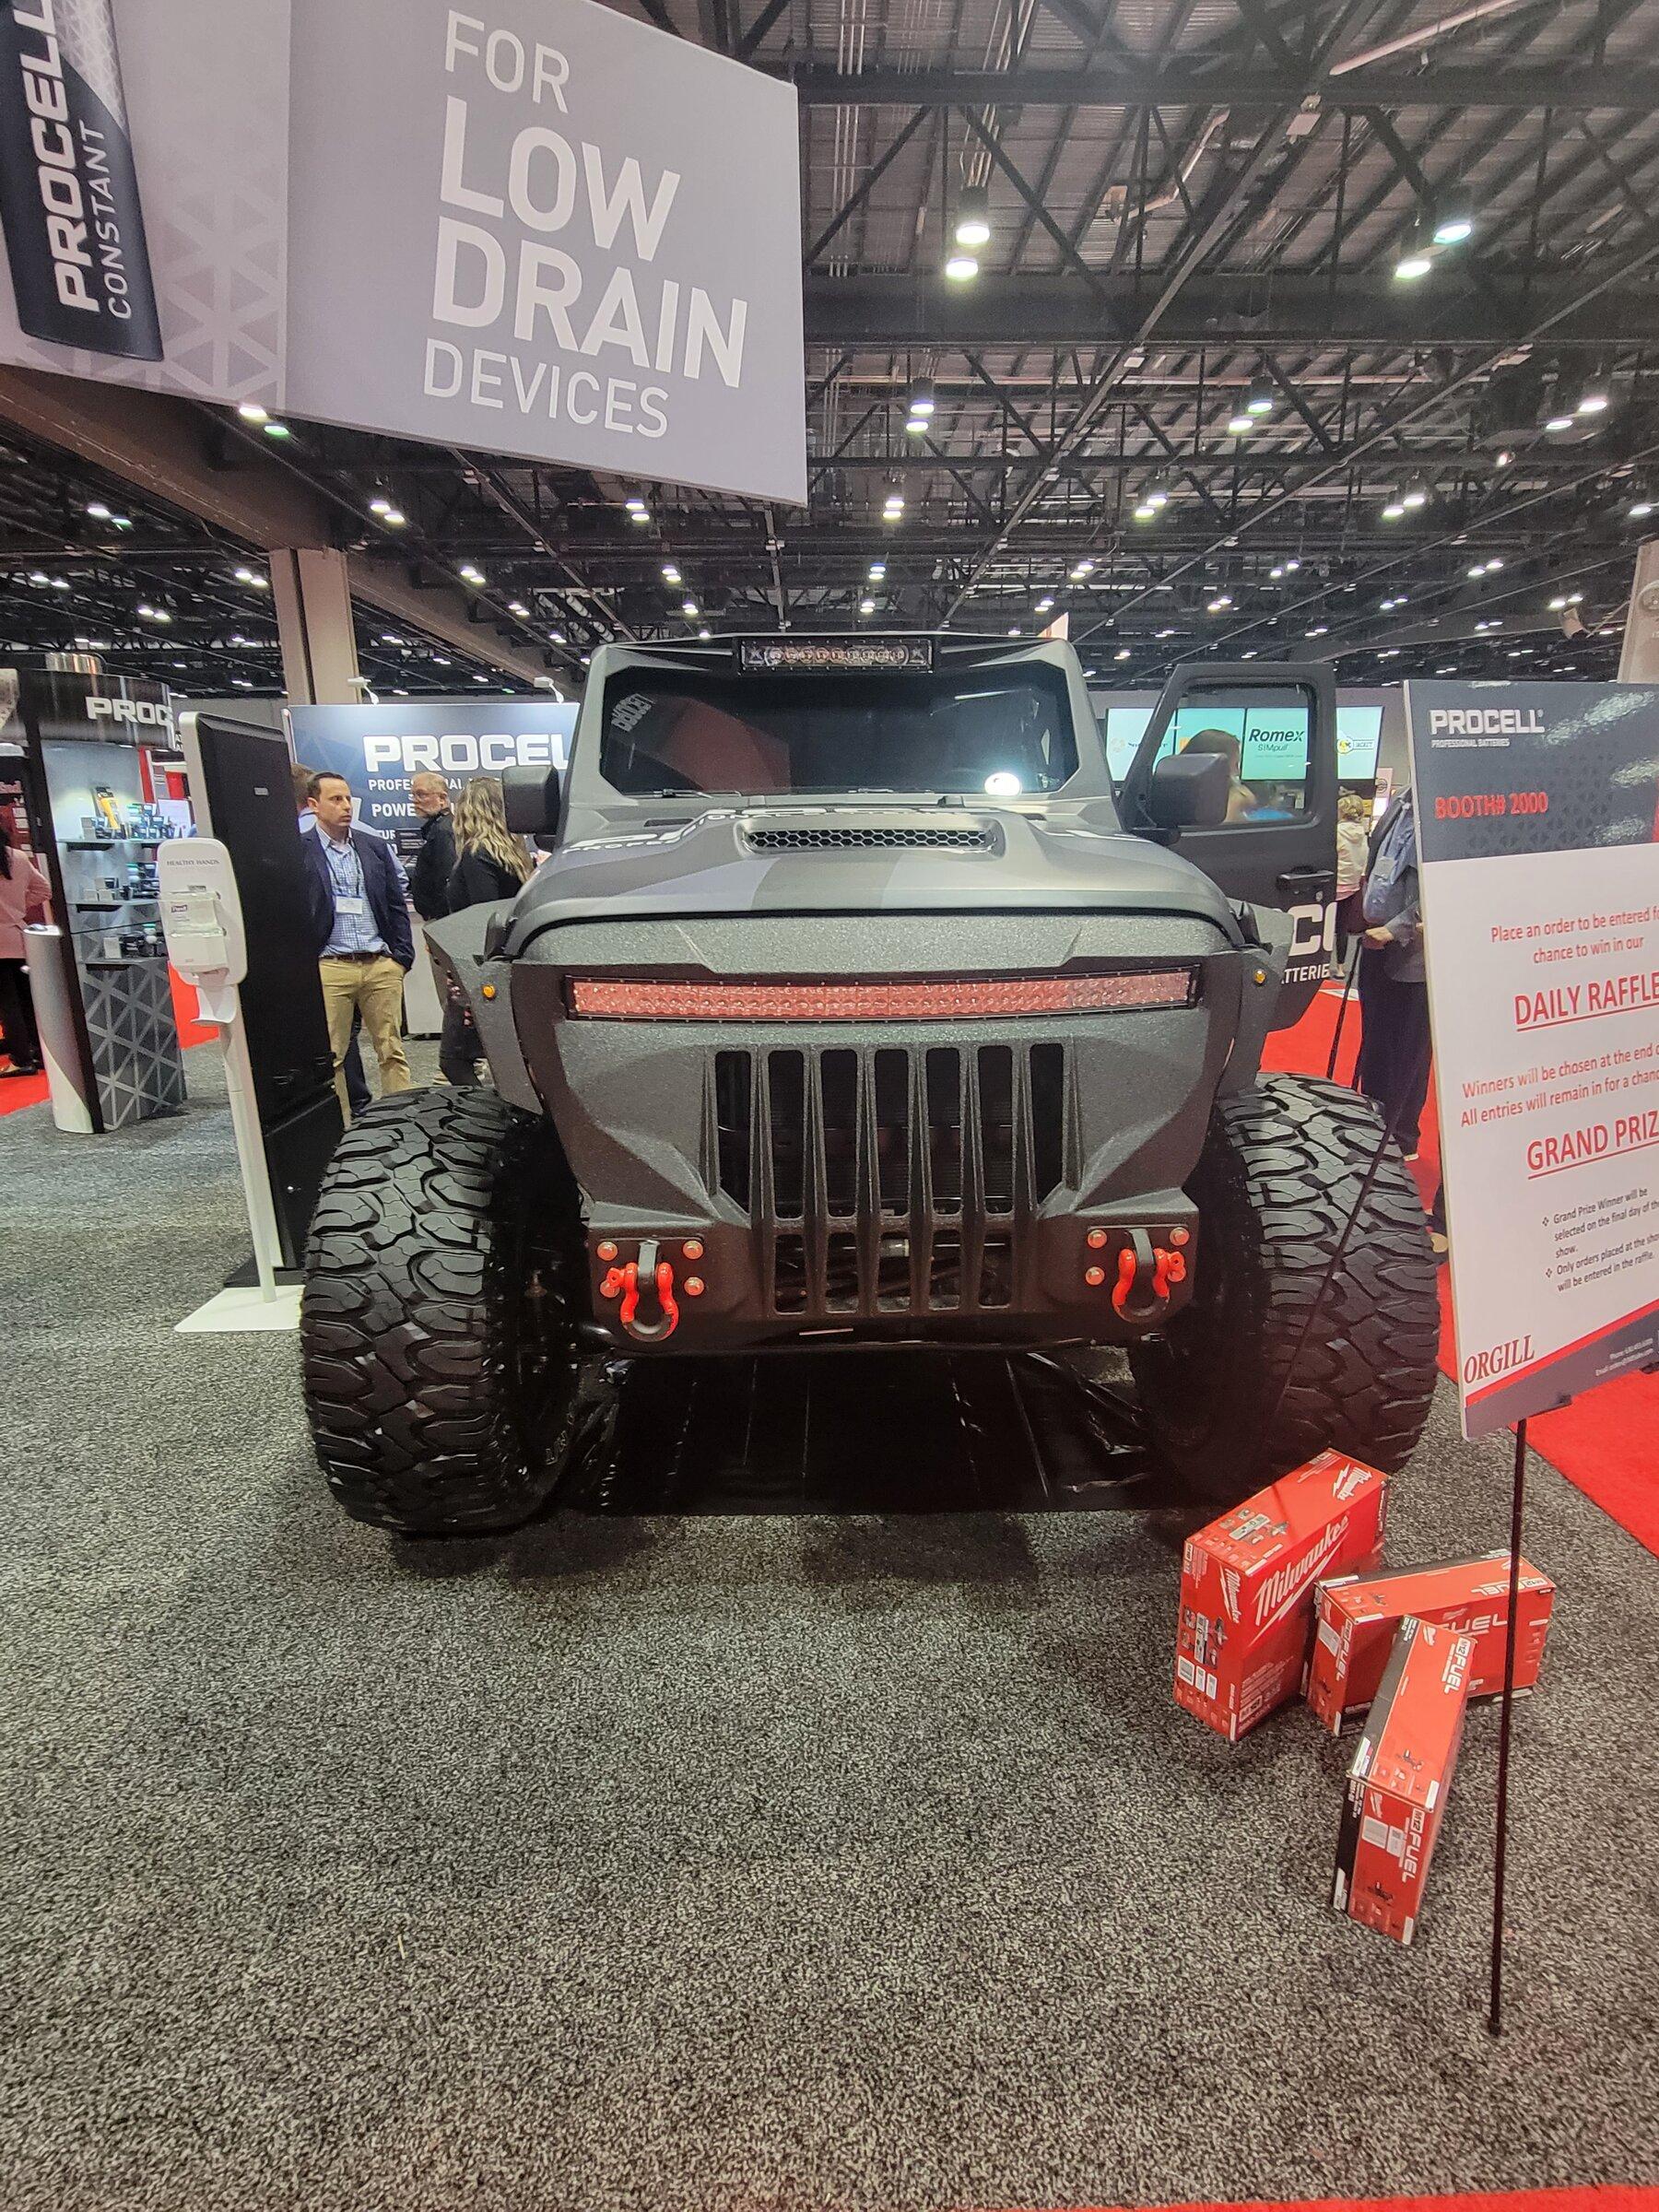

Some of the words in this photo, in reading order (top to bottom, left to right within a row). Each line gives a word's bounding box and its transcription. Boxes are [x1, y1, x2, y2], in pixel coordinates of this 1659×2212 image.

[444, 9, 571, 113] FOR
[13, 0, 100, 313] PROCELL
[440, 95, 681, 262] LOW
[79, 119, 132, 320] CONSTANT
[432, 216, 748, 388] DRAIN
[424, 338, 669, 438] DEVICES
[85, 696, 173, 727] PROC
[1430, 709, 1546, 735] PROCELL
[363, 734, 569, 772] PROCEL
[1249, 728, 1305, 742] Romex
[371, 803, 414, 818] POWE
[1435, 794, 1506, 819] BOOTH#
[1509, 792, 1548, 815] 2000
[1491, 925, 1523, 943] Place
[1526, 926, 1541, 937] an
[1544, 918, 1575, 935] order
[1578, 918, 1590, 931] to
[1593, 913, 1606, 928] be
[1609, 907, 1650, 927] entered
[1534, 947, 1573, 964] chance
[1576, 944, 1588, 958] to
[1591, 939, 1611, 955] win
[1613, 937, 1623, 951] in
[1626, 936, 1644, 949] our
[1281, 963, 1330, 984] TTERIE
[1514, 984, 1581, 1025] DAILY
[1587, 971, 1659, 1011] RAFFLE
[1462, 1076, 1514, 1098] Winners
[1517, 1067, 1538, 1087] will
[1541, 1065, 1557, 1081] be
[1559, 1058, 1597, 1077] chosen
[1600, 1054, 1611, 1068] at
[1613, 1049, 1631, 1065] the
[1633, 1042, 1653, 1060] end
[1461, 1107, 1477, 1127] All
[1481, 1101, 1523, 1123] entries
[1525, 1092, 1547, 1112] will
[1549, 1085, 1589, 1106] remain
[1592, 1081, 1602, 1097] in
[1605, 1077, 1619, 1093] for
[1622, 1077, 1630, 1088] a
[1632, 1069, 1659, 1086] chanc
[1526, 1124, 1609, 1171] GRAND
[1615, 1111, 1659, 1147] PRIZ
[1553, 1207, 1577, 1224] Grand
[1578, 1204, 1596, 1217] Prize
[1597, 1195, 1623, 1210] Winner
[1625, 1189, 1638, 1202] will
[1639, 1188, 1648, 1197] be
[1554, 1222, 1585, 1241] selected
[1586, 1221, 1596, 1231] on
[1597, 1217, 1610, 1228] the
[1611, 1209, 1627, 1222] final
[1629, 1207, 1641, 1218] day
[1642, 1202, 1650, 1213] of
[1556, 1245, 1578, 1259] show.
[1557, 1262, 1574, 1275] Only
[1576, 1253, 1599, 1268] orders
[1601, 1243, 1623, 1262] placed
[1625, 1242, 1632, 1252] at
[1633, 1238, 1645, 1248] the
[1558, 1278, 1571, 1292] will
[1572, 1277, 1583, 1287] be
[1584, 1265, 1612, 1283] entered
[1614, 1263, 1620, 1272] in
[1621, 1258, 1633, 1269] the
[1464, 1335, 1535, 1384] ORGILL
[1251, 1514, 1349, 1627] Milwaukee
[1436, 1614, 1510, 1634] UEL
[1444, 1656, 1467, 1694] FUEL
[1412, 1809, 1424, 1832] M12
[1402, 1831, 1422, 1883] FUEL
